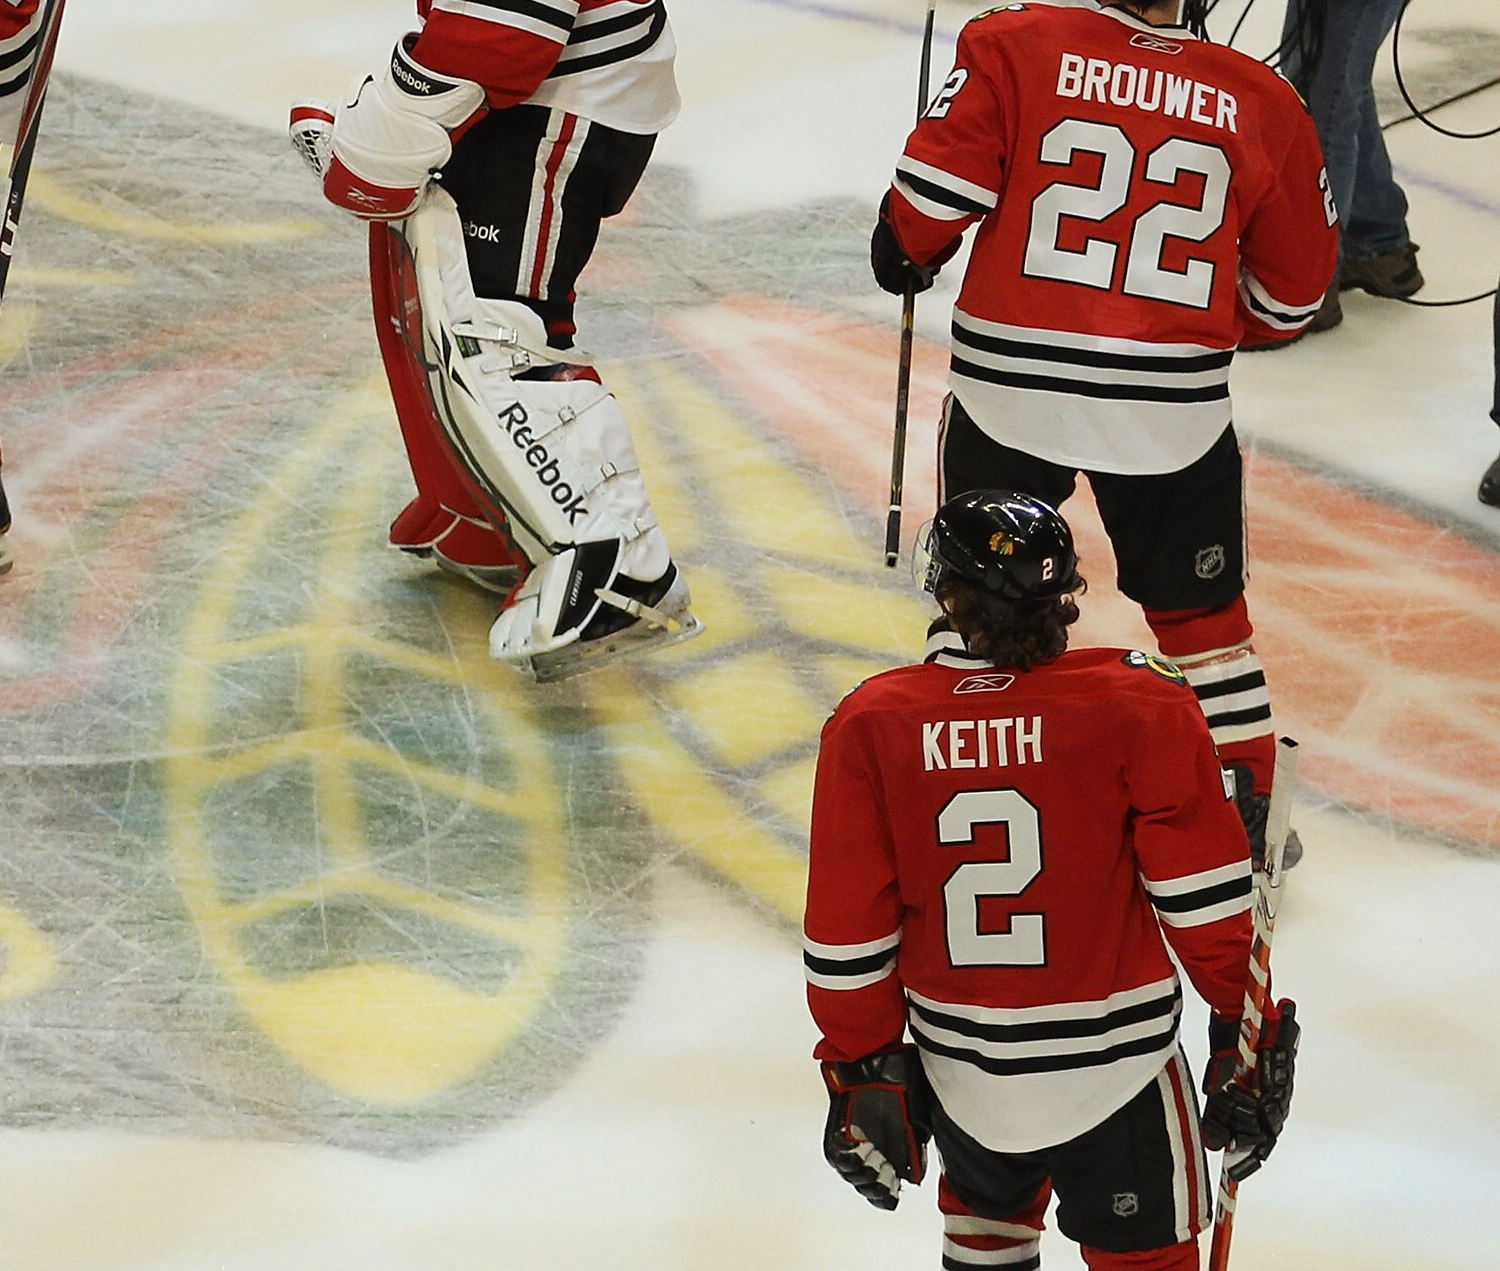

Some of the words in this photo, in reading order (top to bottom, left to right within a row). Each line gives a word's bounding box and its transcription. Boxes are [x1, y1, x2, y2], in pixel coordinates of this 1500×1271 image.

[391, 57, 432, 95] Reebok
[1055, 51, 1239, 135] BROUWER
[1023, 118, 1232, 309] 22
[496, 400, 588, 527] Reebok
[1042, 557, 1054, 582] 2
[921, 715, 1043, 772] KEITH
[938, 789, 1046, 966] 2
